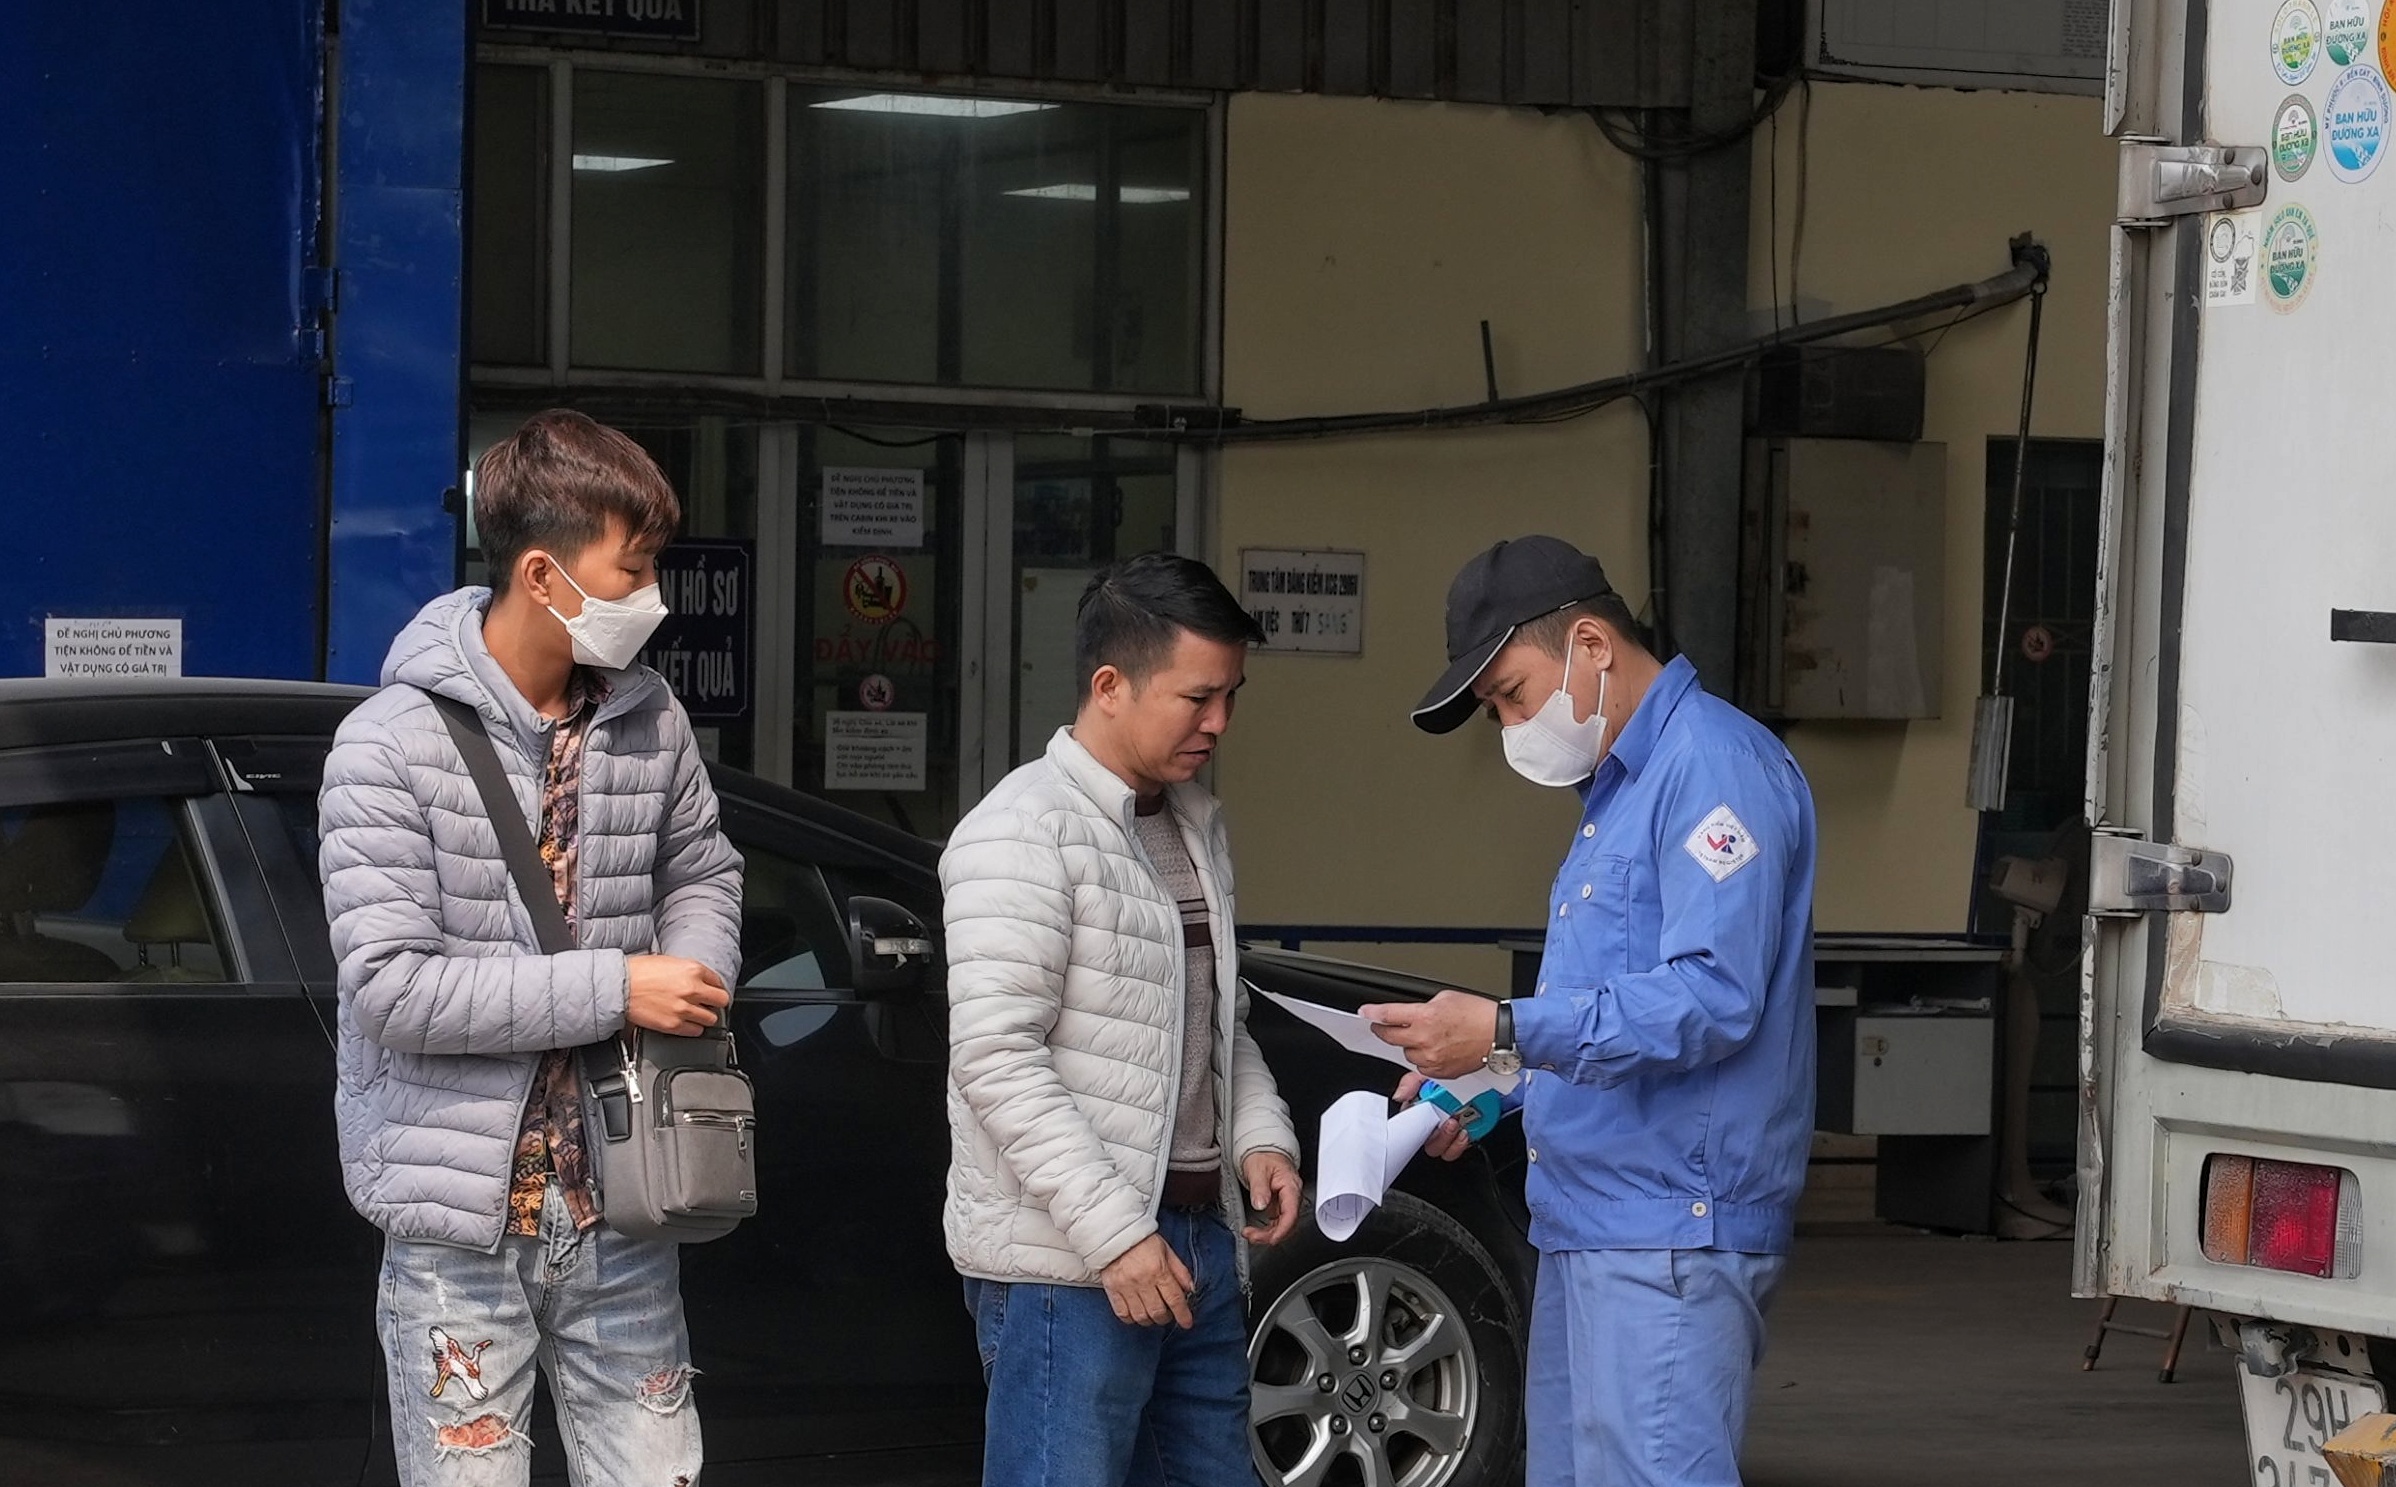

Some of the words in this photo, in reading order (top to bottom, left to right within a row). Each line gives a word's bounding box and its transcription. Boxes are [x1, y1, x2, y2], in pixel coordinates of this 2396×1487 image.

[2356, 32, 2366, 40] XA
[2367, 126, 2379, 138] XA
[2295, 261, 2305, 269] XA
[1271, 566, 1285, 594] TÂM
[713, 566, 738, 616] SƠ
[57, 627, 70, 639] ĐỀ
[73, 629, 98, 640] NGHỊ
[101, 626, 122, 639] CHỦ
[125, 629, 171, 639] PHƯƠNG
[54, 644, 77, 657] TIỆN
[80, 644, 116, 656] KHÔNG
[119, 643, 132, 656] ĐỂ
[135, 643, 156, 656] TIỀN
[159, 644, 173, 656] VÀ
[60, 661, 80, 677] VẬT
[83, 663, 113, 677] DỤNG
[115, 661, 130, 674] CÓ
[131, 661, 150, 674] GIÁ
[152, 663, 167, 677] TRỊ
[697, 636, 735, 701] QUẢ
[2275, 1378, 2350, 1456] 29H
